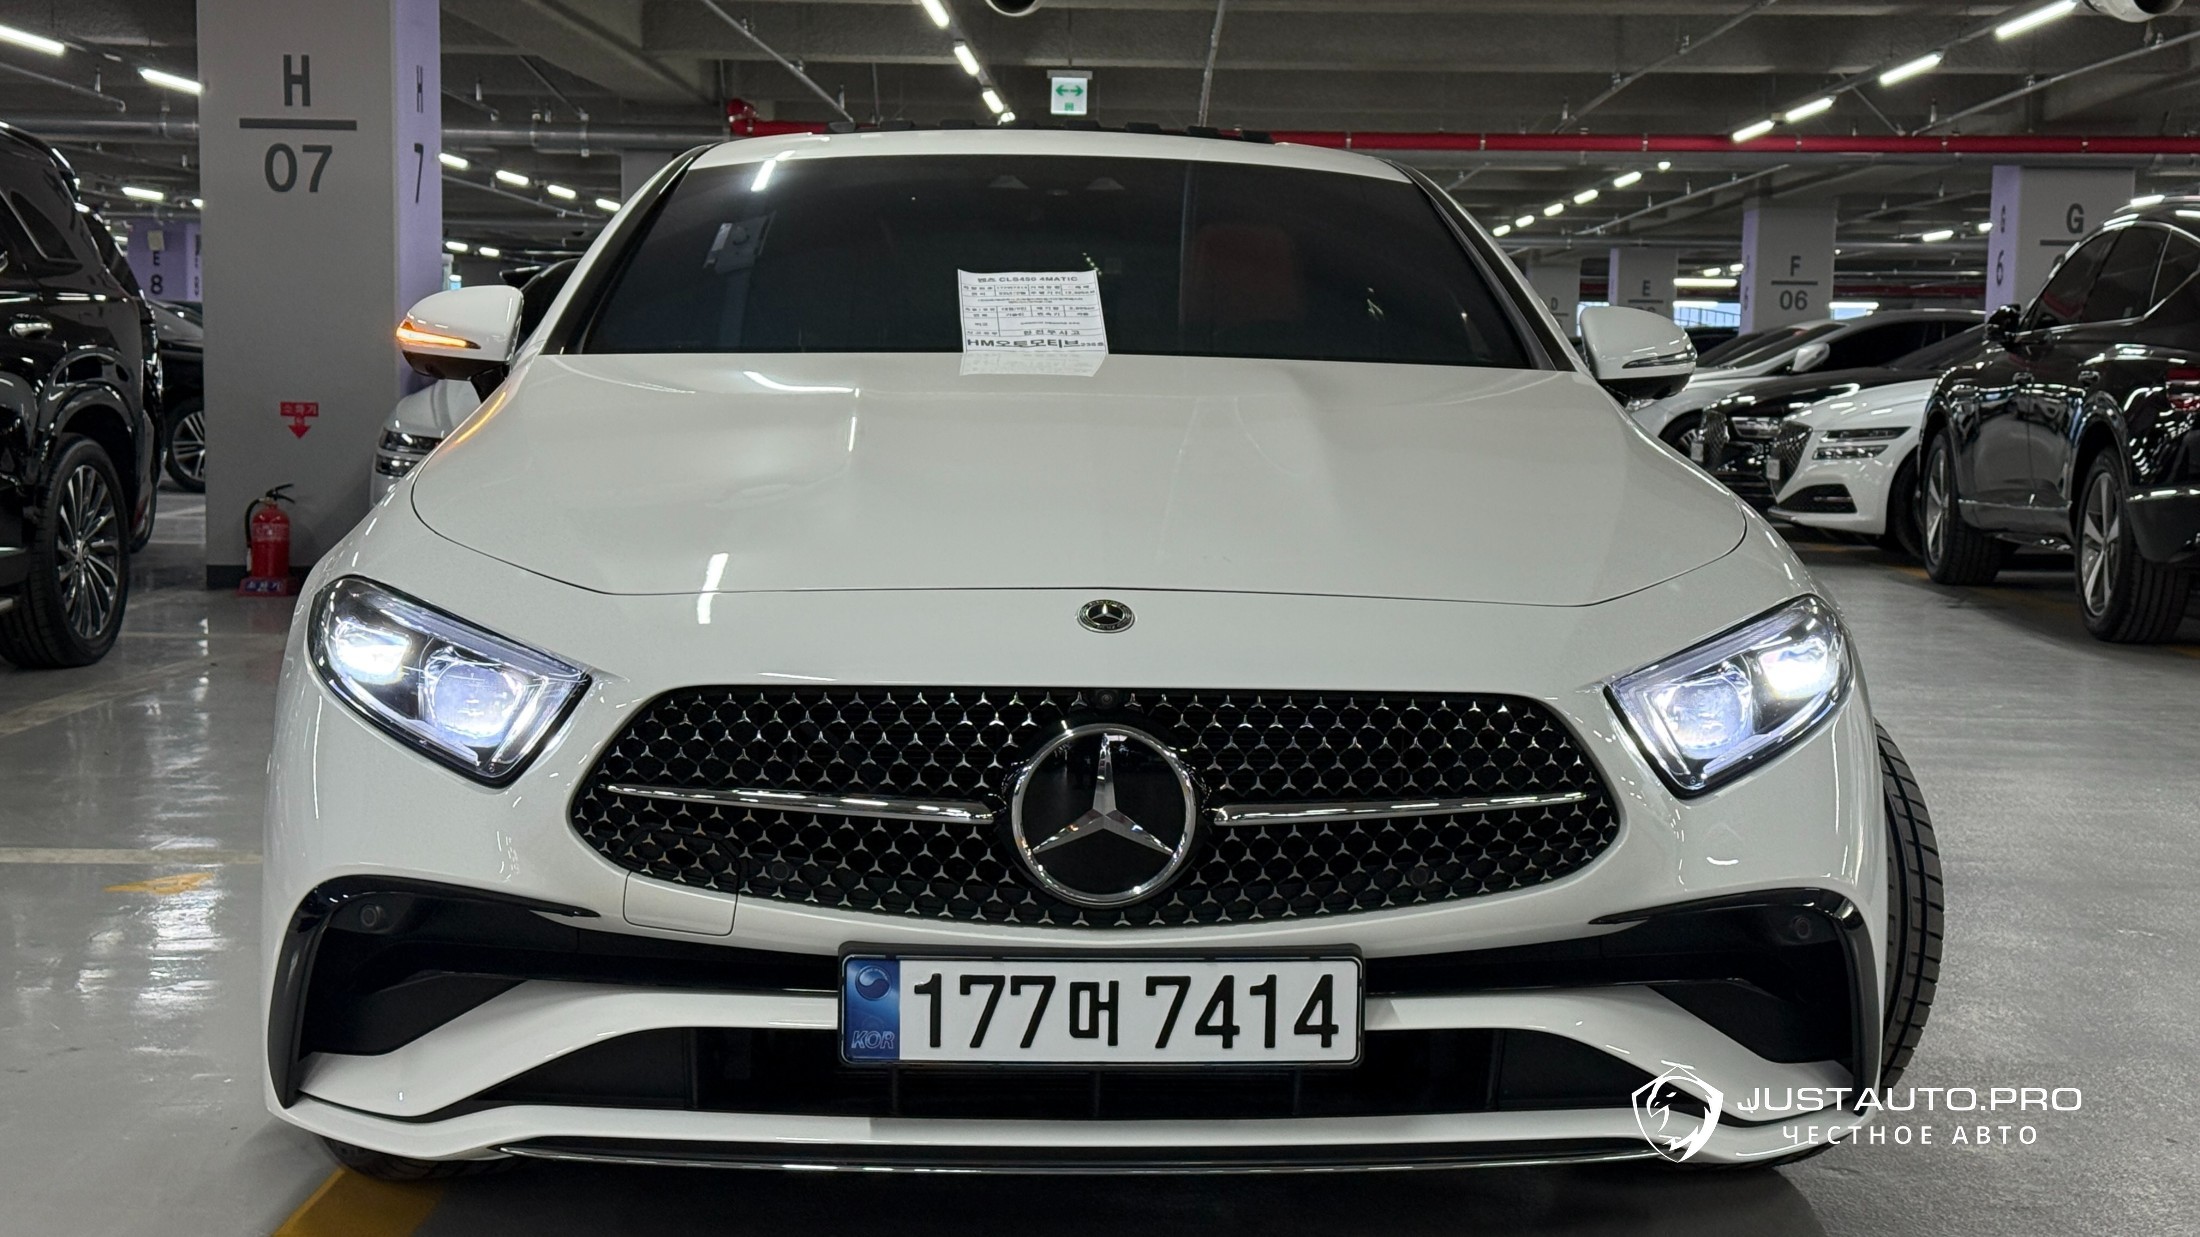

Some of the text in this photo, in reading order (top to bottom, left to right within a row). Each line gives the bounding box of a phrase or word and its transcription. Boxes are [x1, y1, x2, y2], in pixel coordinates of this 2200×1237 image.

[283, 54, 311, 107] H
[415, 64, 424, 113] H
[264, 143, 333, 193] 07
[413, 142, 424, 204] 7
[2066, 202, 2085, 234] G
[153, 251, 161, 266] E
[1790, 255, 1801, 276] F
[1996, 249, 2005, 286] 6
[150, 274, 163, 295] 8
[1641, 280, 1651, 296] E
[1550, 297, 1559, 311] D
[1779, 290, 1808, 310] 06
[914, 974, 1338, 1049] 177머 7414
[851, 1029, 894, 1050] KOR
